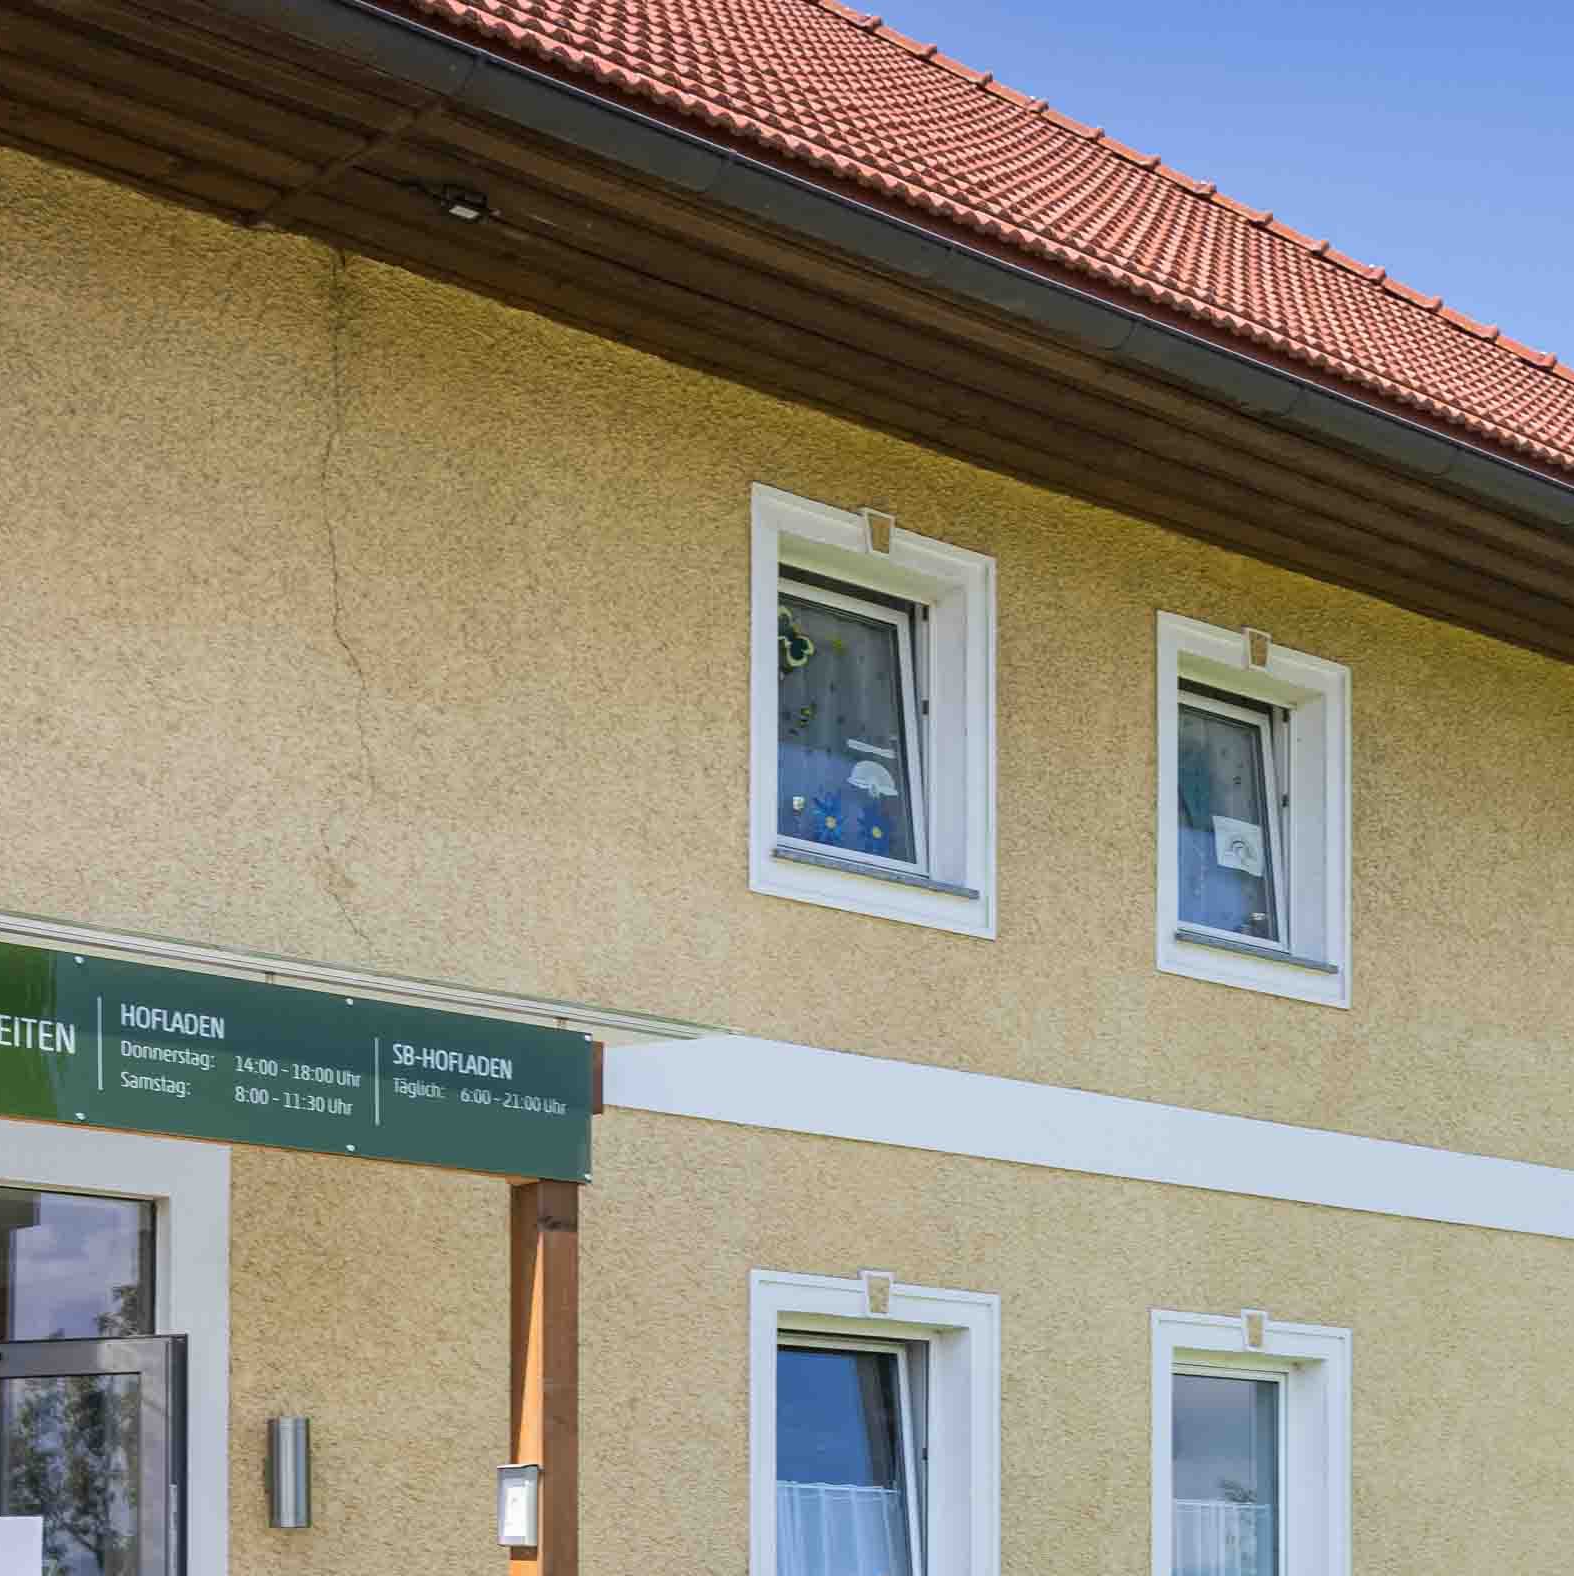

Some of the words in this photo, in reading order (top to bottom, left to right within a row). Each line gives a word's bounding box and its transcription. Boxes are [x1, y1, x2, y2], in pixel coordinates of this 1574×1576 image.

[121, 1003, 225, 1040] HOFLADEN
[120, 1040, 216, 1071] Donnerstag:
[234, 1055, 278, 1078] 14:00
[291, 1063, 334, 1085] 18:00
[336, 1071, 362, 1088] Uhr
[392, 1043, 513, 1081] SB-HOFLADEN
[120, 1071, 192, 1098] Samstag:
[234, 1085, 270, 1105] 8:00
[283, 1091, 325, 1113] 11:30
[327, 1098, 353, 1116] Uhr
[392, 1077, 446, 1099] Täglich:
[460, 1087, 492, 1105] 6:00
[502, 1092, 541, 1113] 21:00
[543, 1099, 568, 1115] Uhr
